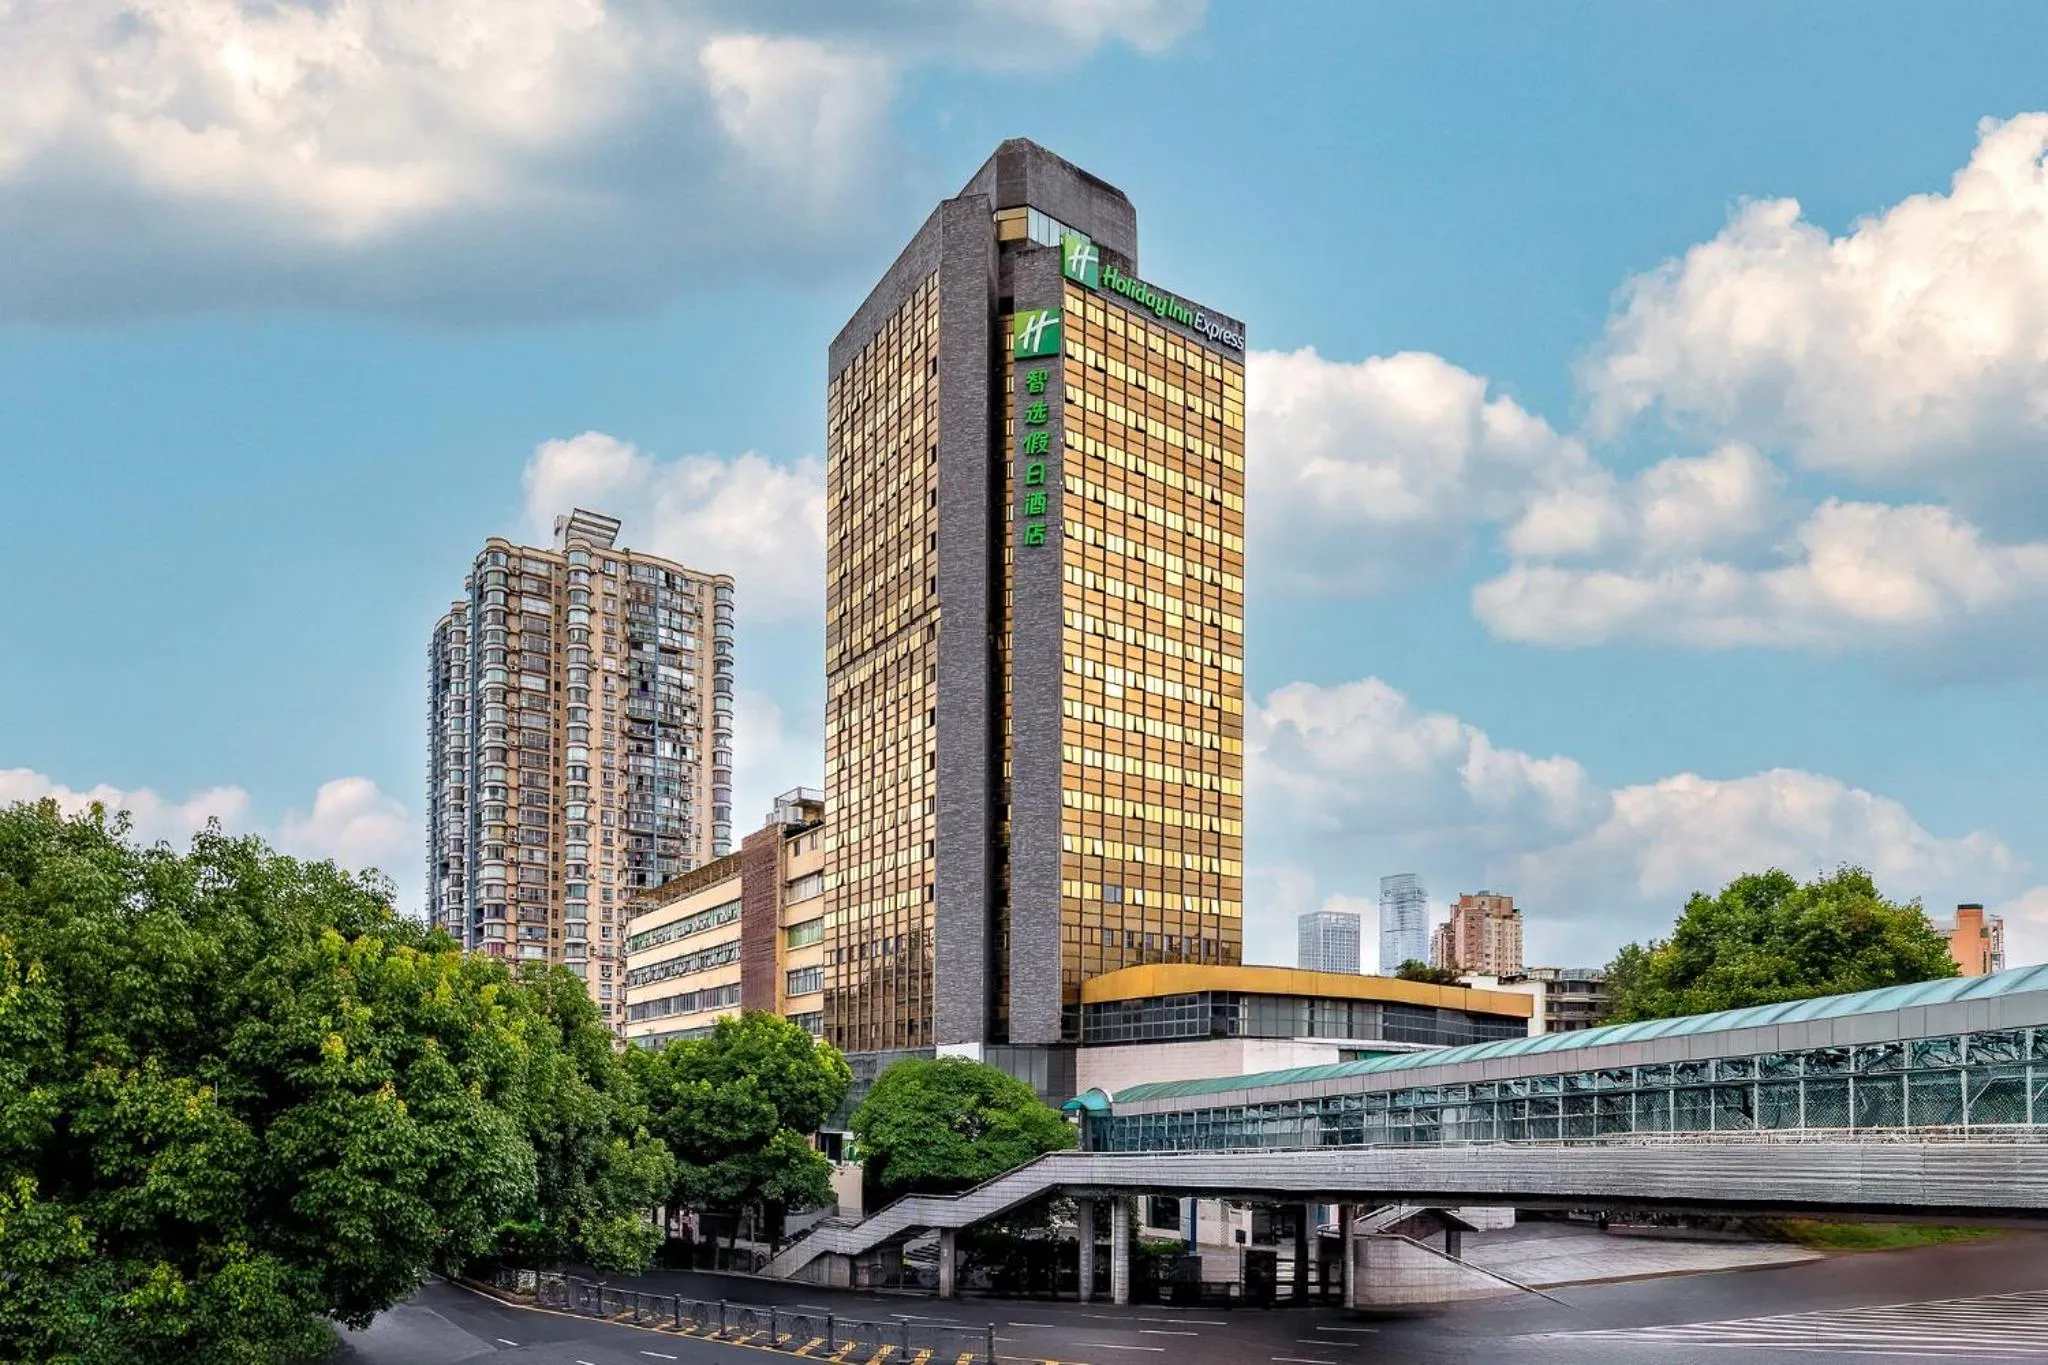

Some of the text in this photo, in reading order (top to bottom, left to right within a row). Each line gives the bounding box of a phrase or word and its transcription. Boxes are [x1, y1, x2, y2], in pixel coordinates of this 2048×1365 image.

[1102, 264, 1244, 350] Holiday Inn Express
[1023, 368, 1050, 547] 智选假日酒店
